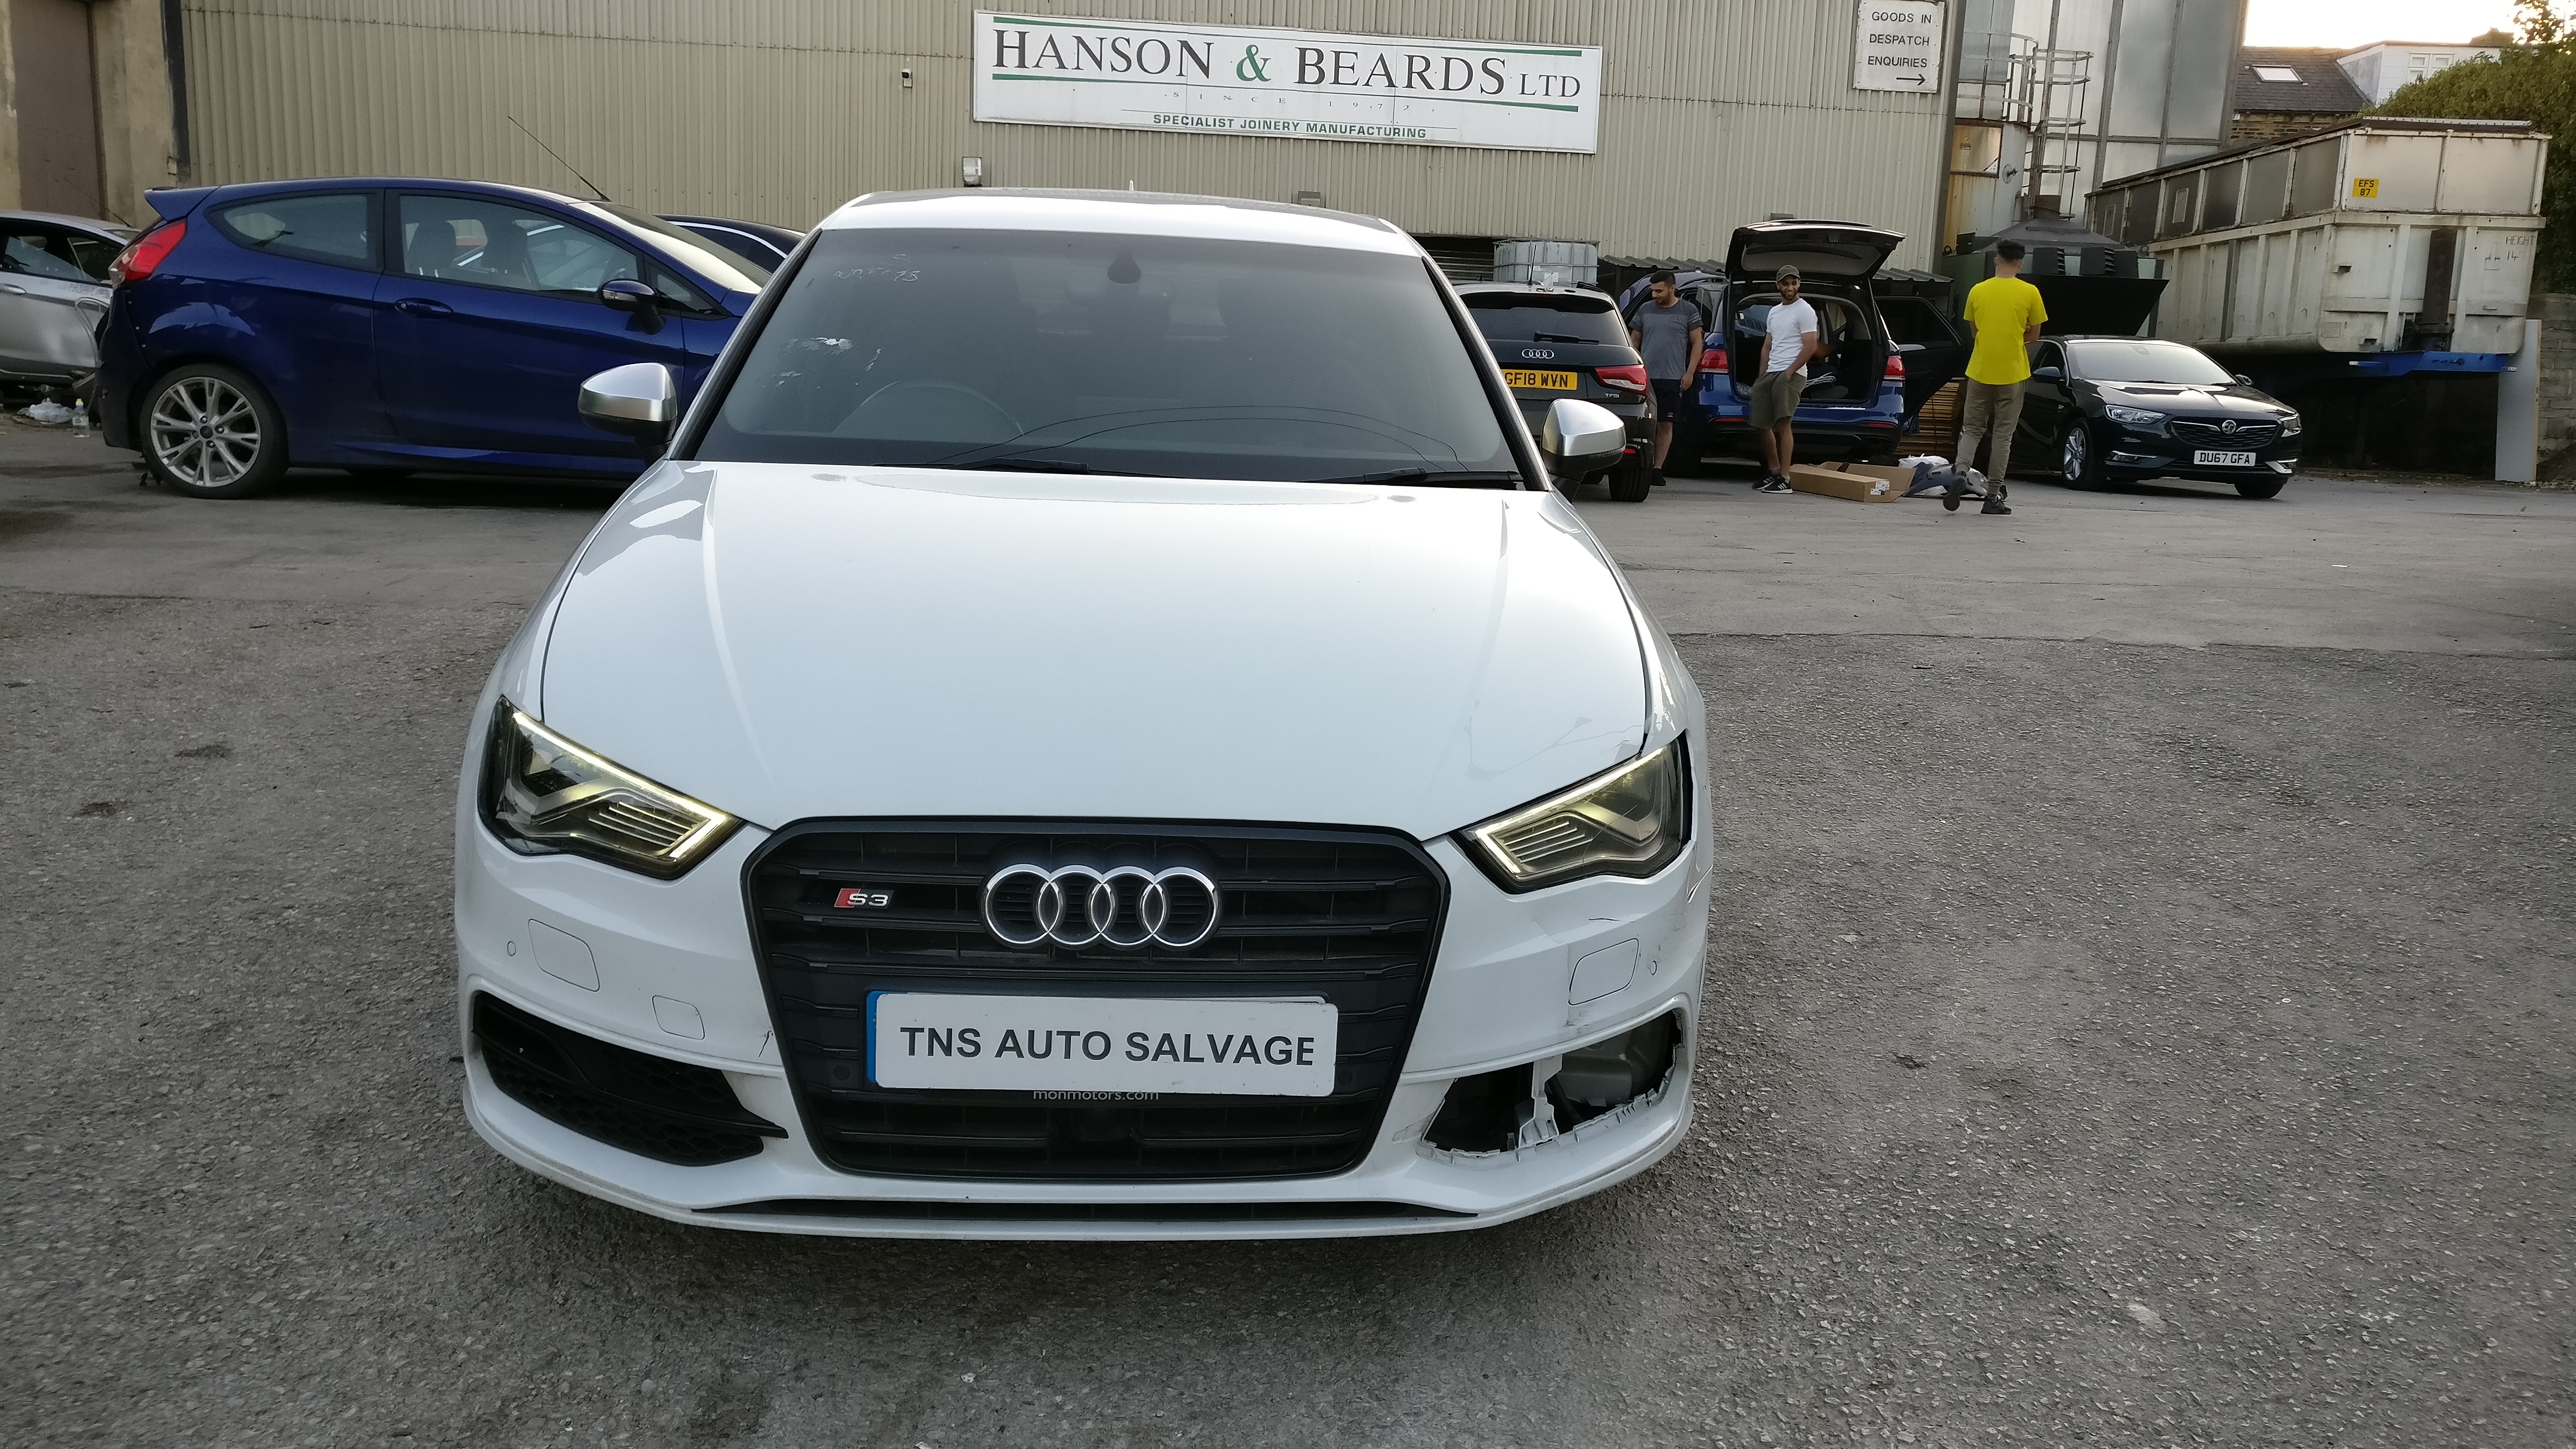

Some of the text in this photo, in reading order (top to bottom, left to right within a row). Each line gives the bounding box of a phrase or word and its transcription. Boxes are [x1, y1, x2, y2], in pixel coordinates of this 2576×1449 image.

[1871, 11, 1932, 24] GOODS IN
[1869, 33, 1930, 46] DESPATCH
[993, 29, 1581, 97] HANSON & BEARDS LTD
[1868, 56, 1928, 68] ENQUIRIES
[1173, 91, 1410, 111] SINCE 1972
[1153, 114, 1427, 138] SPECIALIST JOINERY MANUFACTURING
[2505, 235, 2537, 245] HEIGHT
[1505, 372, 1568, 388] GF18 WVN
[2198, 452, 2250, 465] DU67 GFA
[847, 893, 888, 906] S3
[900, 1027, 1315, 1066] TNS AUTO SALVAGE
[1033, 1090, 1159, 1100] monmotors.com
